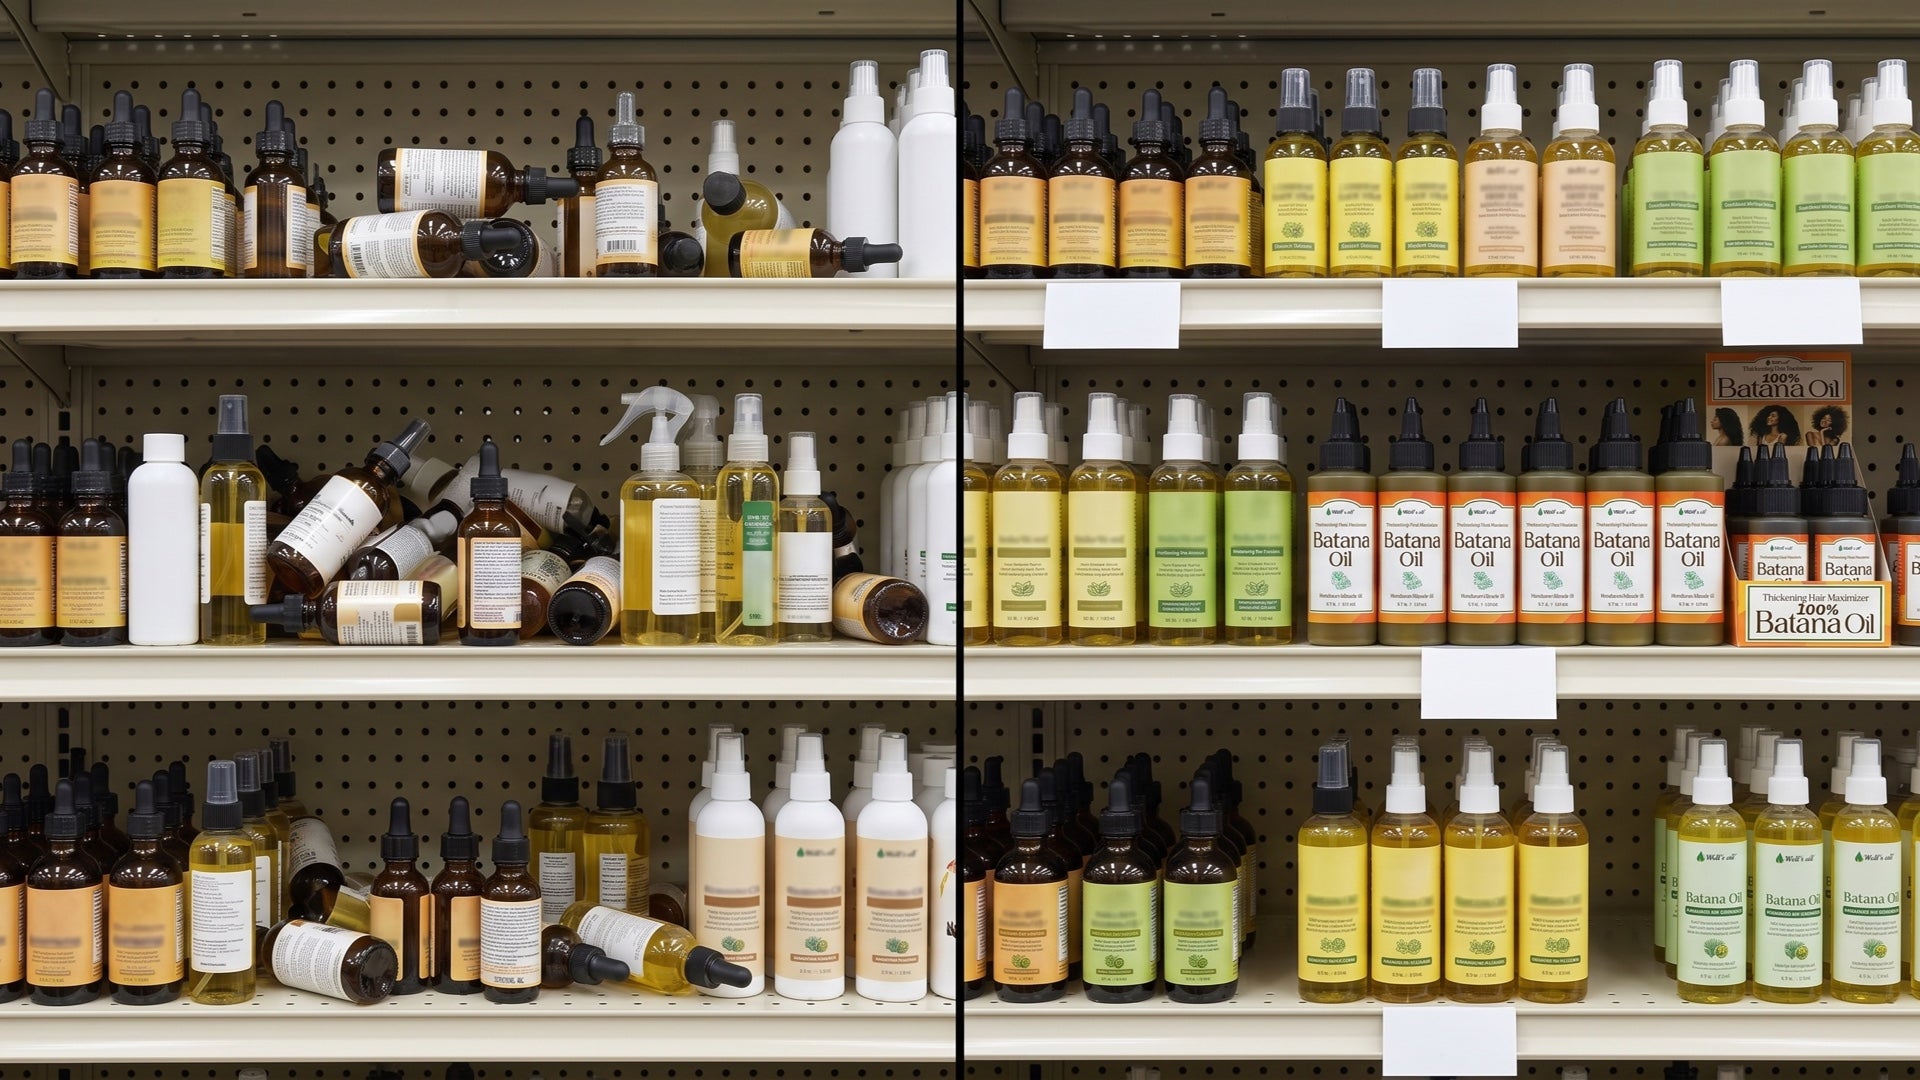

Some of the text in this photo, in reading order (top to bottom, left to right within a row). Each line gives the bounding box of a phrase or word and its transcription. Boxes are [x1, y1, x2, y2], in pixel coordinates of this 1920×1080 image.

[1717, 377, 1841, 398] Batana Oil
[1761, 373, 1801, 384] 100%
[1313, 531, 1370, 549] Batana
[1384, 531, 1441, 549] Batana
[1454, 531, 1512, 549] Batana
[1524, 531, 1581, 549] Batana
[1593, 531, 1651, 549] Batana
[1664, 531, 1721, 549] Batana
[1328, 550, 1353, 568] Oil
[1399, 550, 1424, 568] Oil
[1470, 550, 1495, 568] Oil
[1540, 550, 1564, 568] Oil
[1610, 550, 1635, 568] Oil
[1681, 550, 1705, 568] Oil
[1757, 561, 1805, 576] Batana
[1825, 561, 1873, 576] Batana
[1762, 593, 1870, 604] Thickening Hair Maximizer
[1796, 603, 1839, 616] 100%
[1755, 609, 1875, 634] Batana Oil
[1686, 891, 1743, 905] Batana Oil
[1766, 893, 1821, 907] Batana Oil
[1843, 891, 1885, 905] Batana
